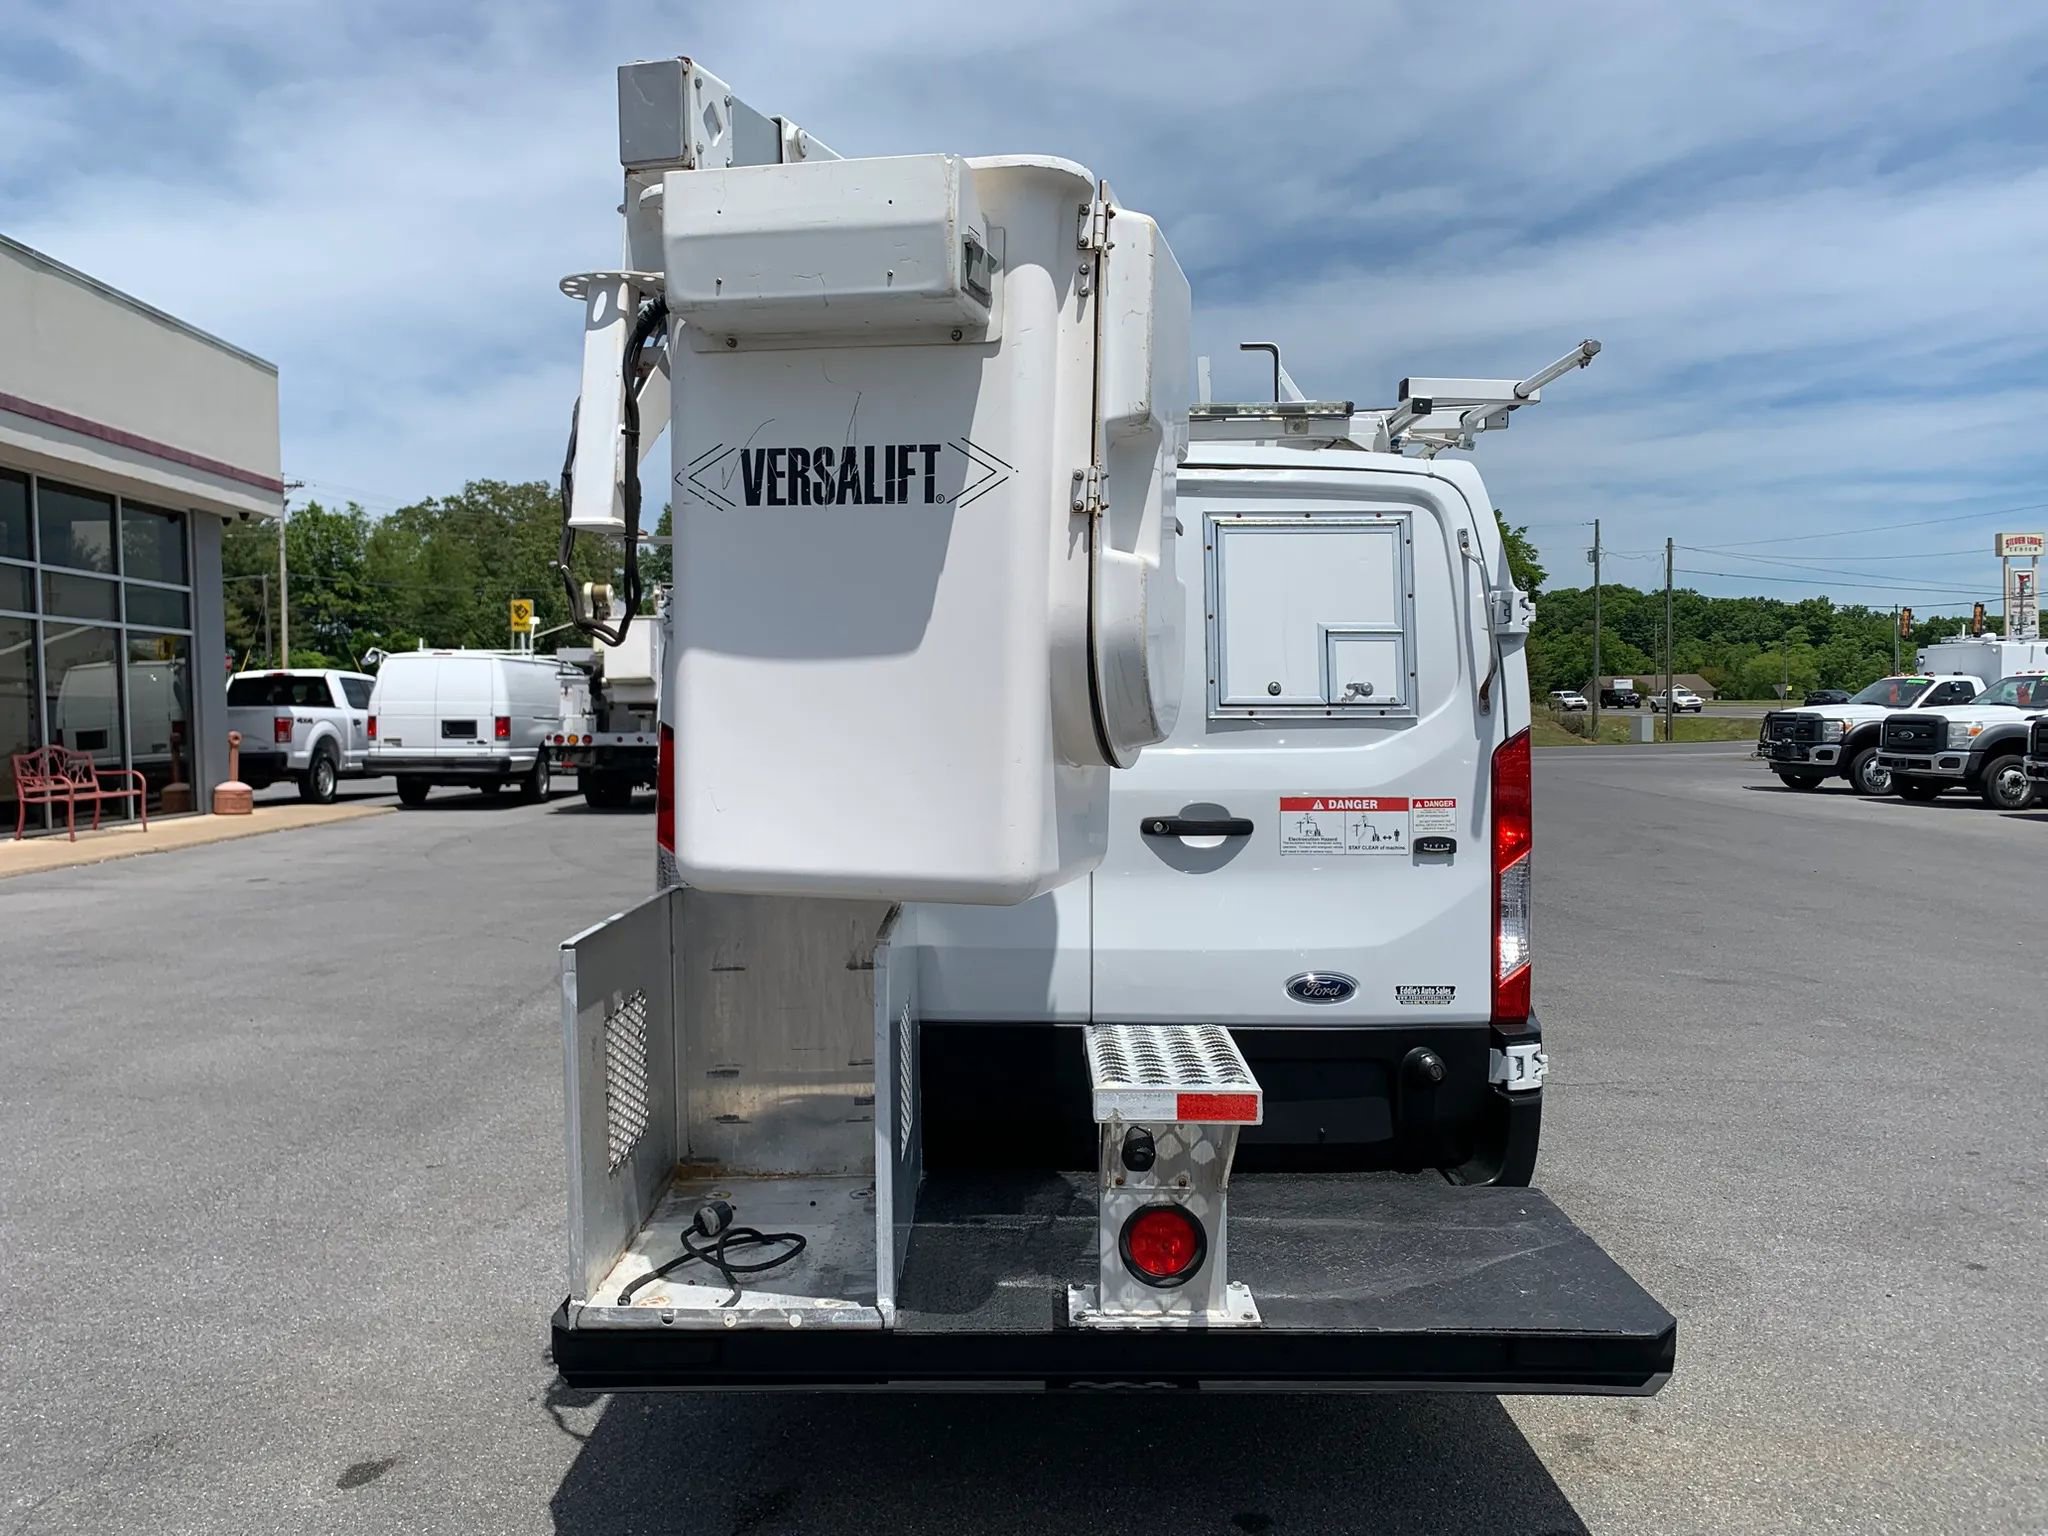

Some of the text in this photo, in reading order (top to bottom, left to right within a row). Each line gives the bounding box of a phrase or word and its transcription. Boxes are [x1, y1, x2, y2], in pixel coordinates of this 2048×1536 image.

[741, 443, 942, 507] VERSALIFT
[2005, 536, 2043, 548] SILVER LAKE
[1327, 799, 1378, 810] DANGER
[1423, 800, 1455, 808] DANGER
[1303, 979, 1342, 996] Ford
[1420, 986, 1435, 995] Auto
[1435, 986, 1451, 995] Sales
